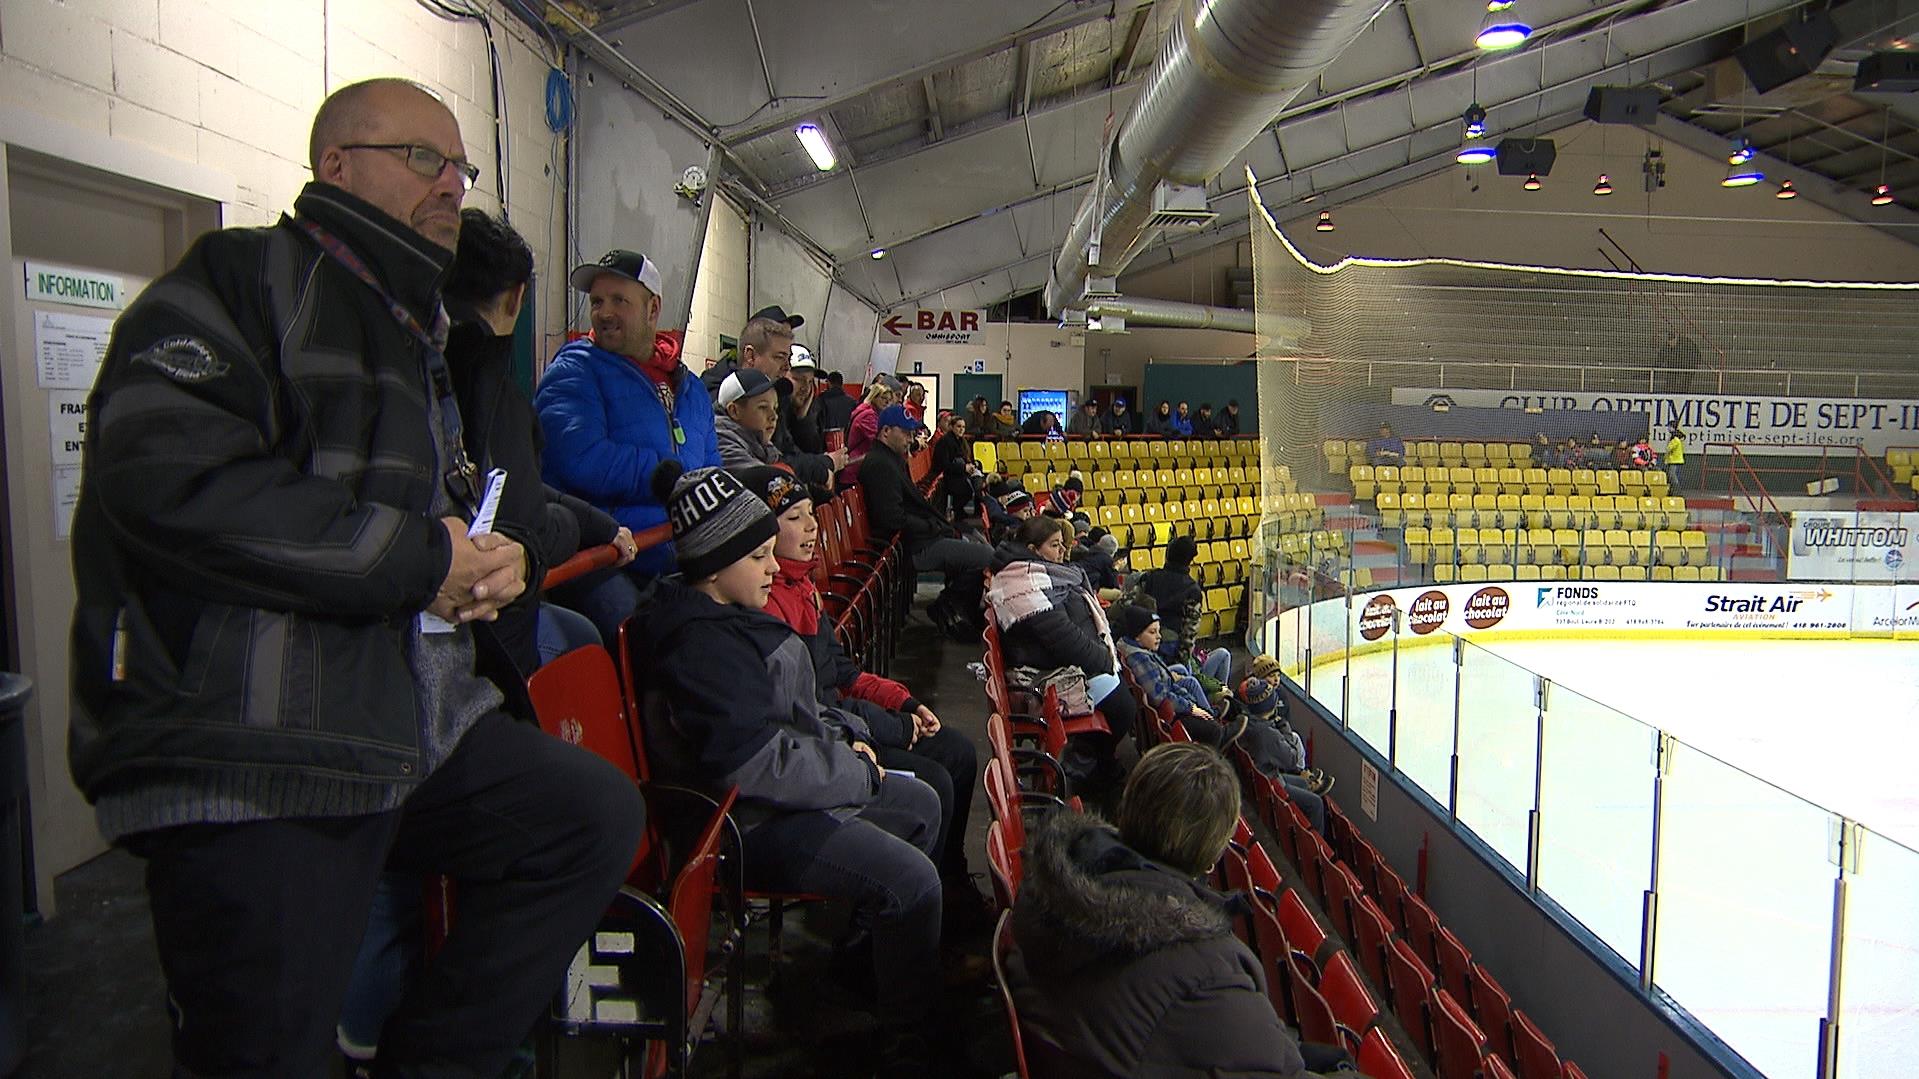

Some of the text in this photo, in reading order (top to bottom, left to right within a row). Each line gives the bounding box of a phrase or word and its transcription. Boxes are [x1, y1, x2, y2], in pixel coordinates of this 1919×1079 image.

[38, 272, 115, 302] INFORMATION
[917, 310, 979, 331] BAR
[1770, 402, 1813, 429] DE
[1647, 428, 1864, 446] luptimiste-sept-iles.org
[1804, 527, 1908, 548] WHITTOM
[1472, 593, 1507, 607] lait au
[1557, 587, 1599, 599] FONDS
[1415, 598, 1447, 612] lait au
[1464, 605, 1508, 620] chocolat
[1705, 595, 1804, 613] Strait Air
[567, 931, 637, 1023] E
